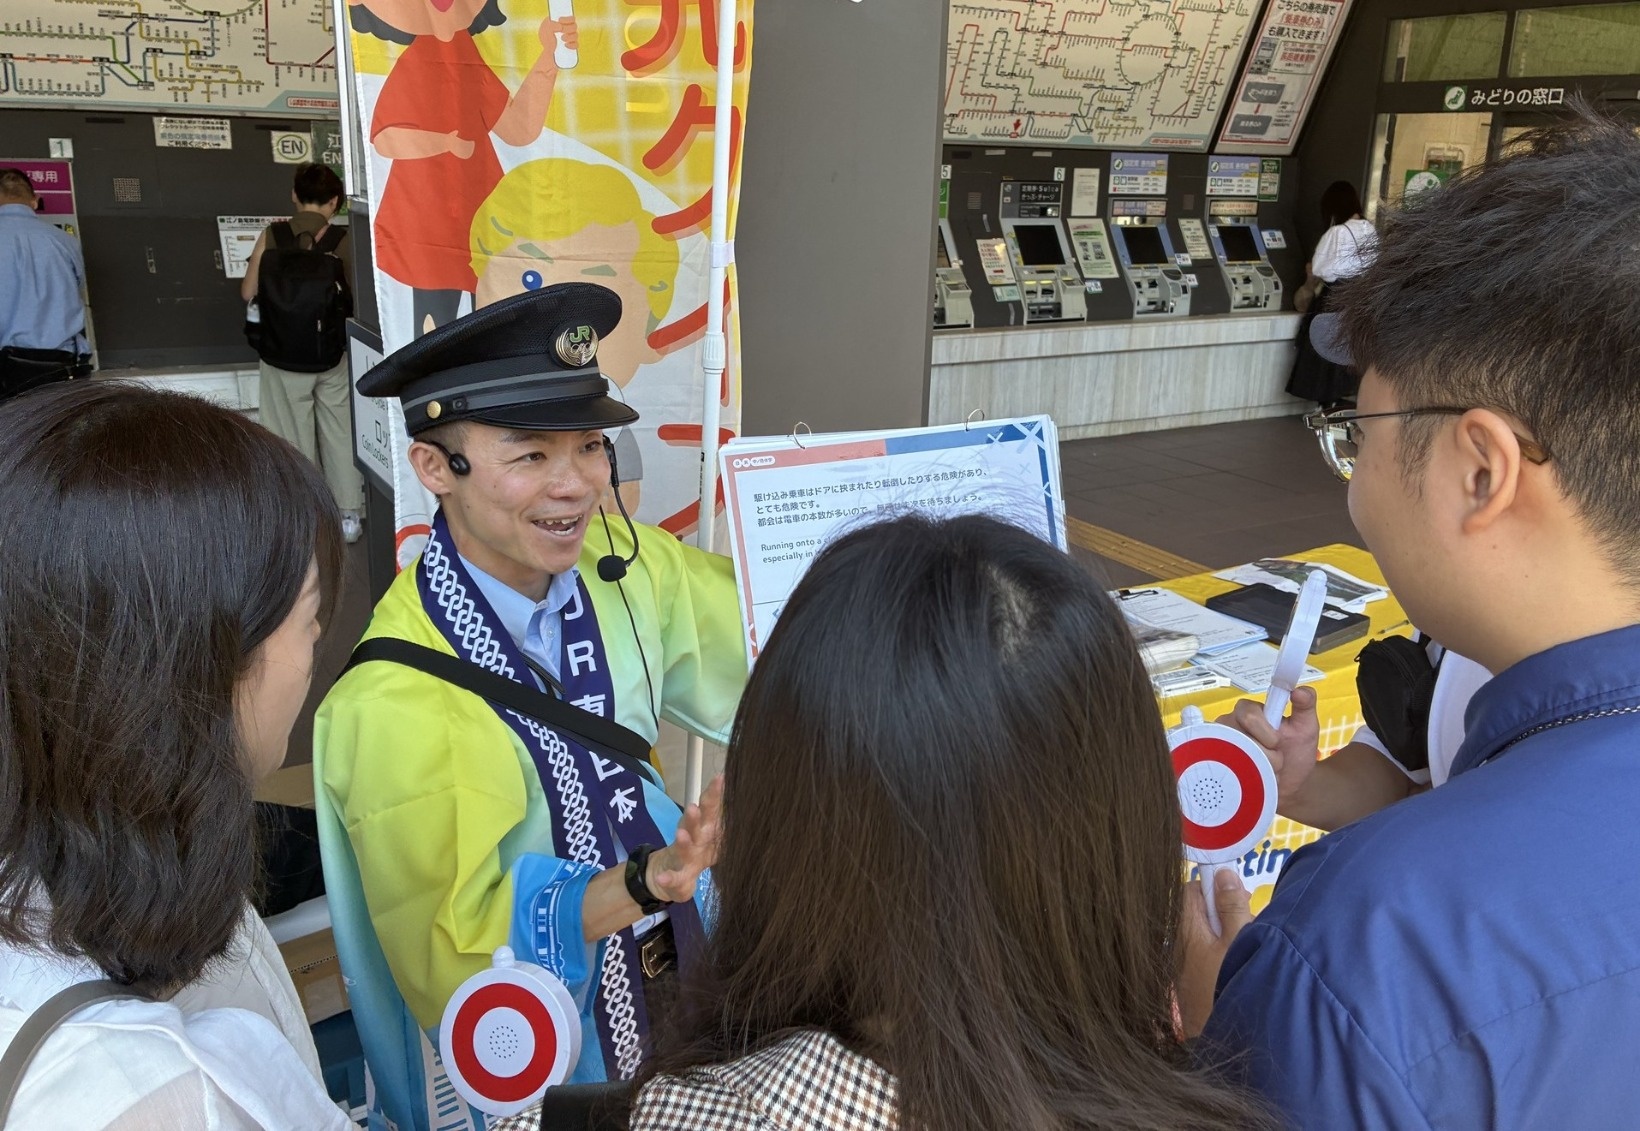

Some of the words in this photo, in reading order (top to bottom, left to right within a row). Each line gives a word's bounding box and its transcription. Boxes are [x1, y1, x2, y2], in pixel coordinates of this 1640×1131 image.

[1471, 87, 1565, 106] みどりの窓口
[55, 140, 65, 157] 1
[281, 140, 303, 154] EN
[942, 166, 949, 178] 5
[1056, 169, 1063, 180] 6
[570, 325, 591, 343] JR
[756, 499, 820, 515] とても危険です。
[761, 541, 794, 552] Running
[795, 539, 815, 548] onto
[762, 550, 804, 564] especially
[805, 551, 813, 559] in
